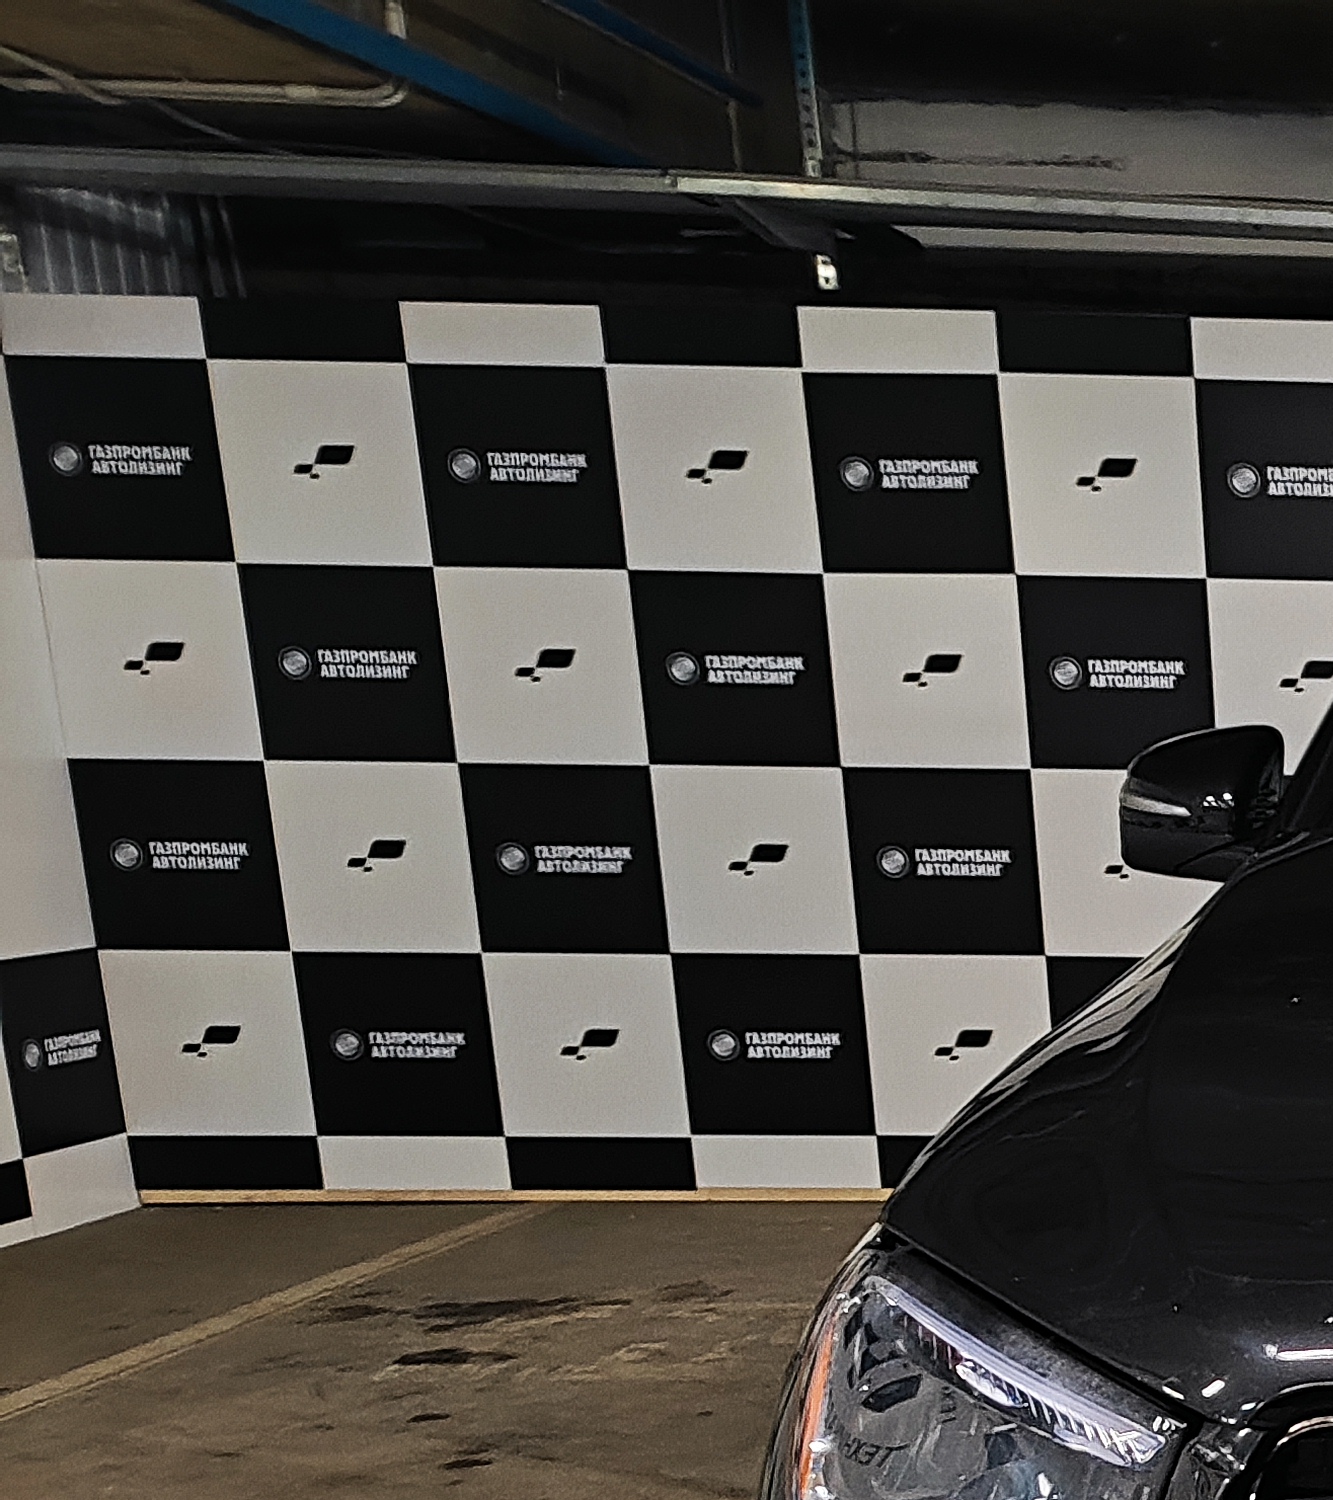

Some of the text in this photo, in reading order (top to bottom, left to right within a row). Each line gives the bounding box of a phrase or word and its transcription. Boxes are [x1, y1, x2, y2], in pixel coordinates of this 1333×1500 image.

[88, 445, 191, 460] ГАЗПРОМБАНК
[92, 460, 182, 475] АВТОЛИЗИНГ
[879, 459, 978, 474] ГАЗПРОМБАНК
[882, 475, 970, 489] АВТОЛИЗИНГ
[318, 649, 417, 664] ГАЗПРОМБАНК
[705, 655, 804, 670] ГАЗПРОМБАНК
[321, 664, 409, 678] АВТОЛИЗИНГ
[1088, 660, 1185, 675] ГАЗПРОМБАНК
[708, 670, 796, 684] АВТОЛИЗИНГ
[1090, 674, 1177, 689] АВТОЛИЗИНГ
[149, 842, 248, 856] ГАЗПРОМБАНК
[915, 849, 1011, 863] ГАЗПРОМБАНК
[153, 856, 240, 869] АВТОЛИЗИНГ
[917, 863, 1003, 876] АВТОЛИЗИНГ
[745, 1032, 840, 1045] ГАЗПРОМБАНК
[748, 1046, 833, 1058] АВТОЛИЗИНГ
